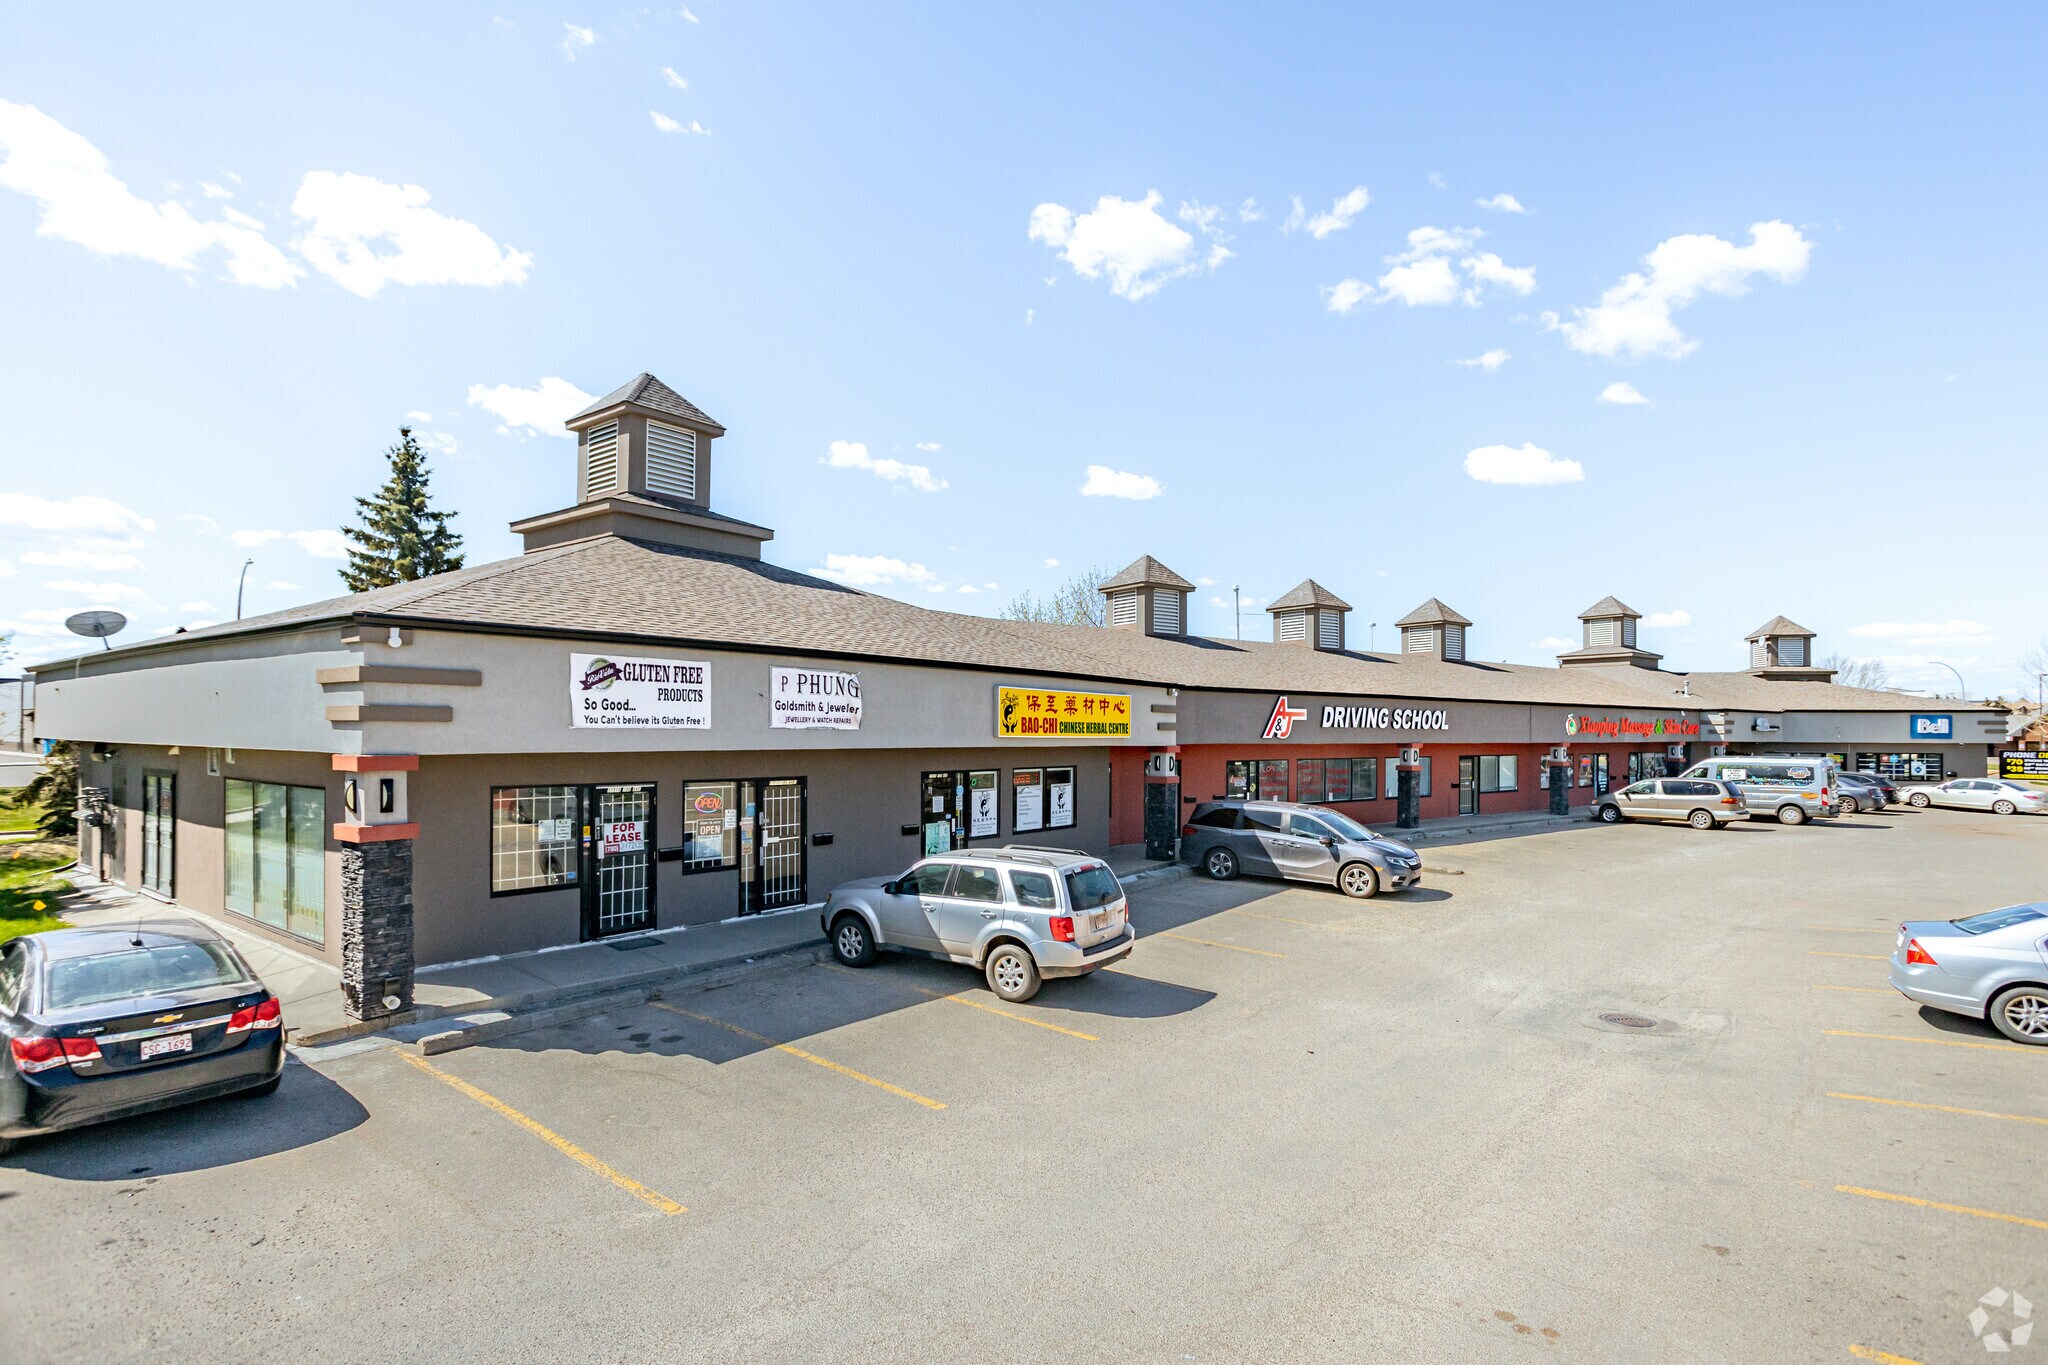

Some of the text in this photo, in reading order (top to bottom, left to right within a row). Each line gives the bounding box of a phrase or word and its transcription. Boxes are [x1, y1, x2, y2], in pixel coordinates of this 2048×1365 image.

[623, 662, 703, 685] GLUTEN FREE
[781, 673, 860, 698] P PHUNG
[657, 687, 703, 702] PRODUCTS
[584, 697, 636, 711] So Good...
[774, 699, 860, 715] Goldsmith & Jeweler
[584, 715, 598, 724] You
[601, 714, 620, 725] Can't
[623, 715, 650, 725] believe
[651, 715, 660, 725] its
[662, 716, 685, 725] Gluten
[687, 716, 701, 725] Free
[784, 716, 811, 724] JEWELLERY
[1021, 716, 1129, 734] BAO-CHI CHINESE HERBAL CENTRE
[1321, 706, 1449, 730] DRIVING SCHOOL
[1579, 716, 1699, 738] Xiaoping Massage & Skin Care
[1917, 718, 1949, 734] Bell
[698, 797, 720, 809] OPEN
[612, 822, 635, 833] FOR
[700, 824, 720, 835] OPEN
[605, 831, 642, 844] LEASE
[142, 1038, 192, 1056] CSC-1692
